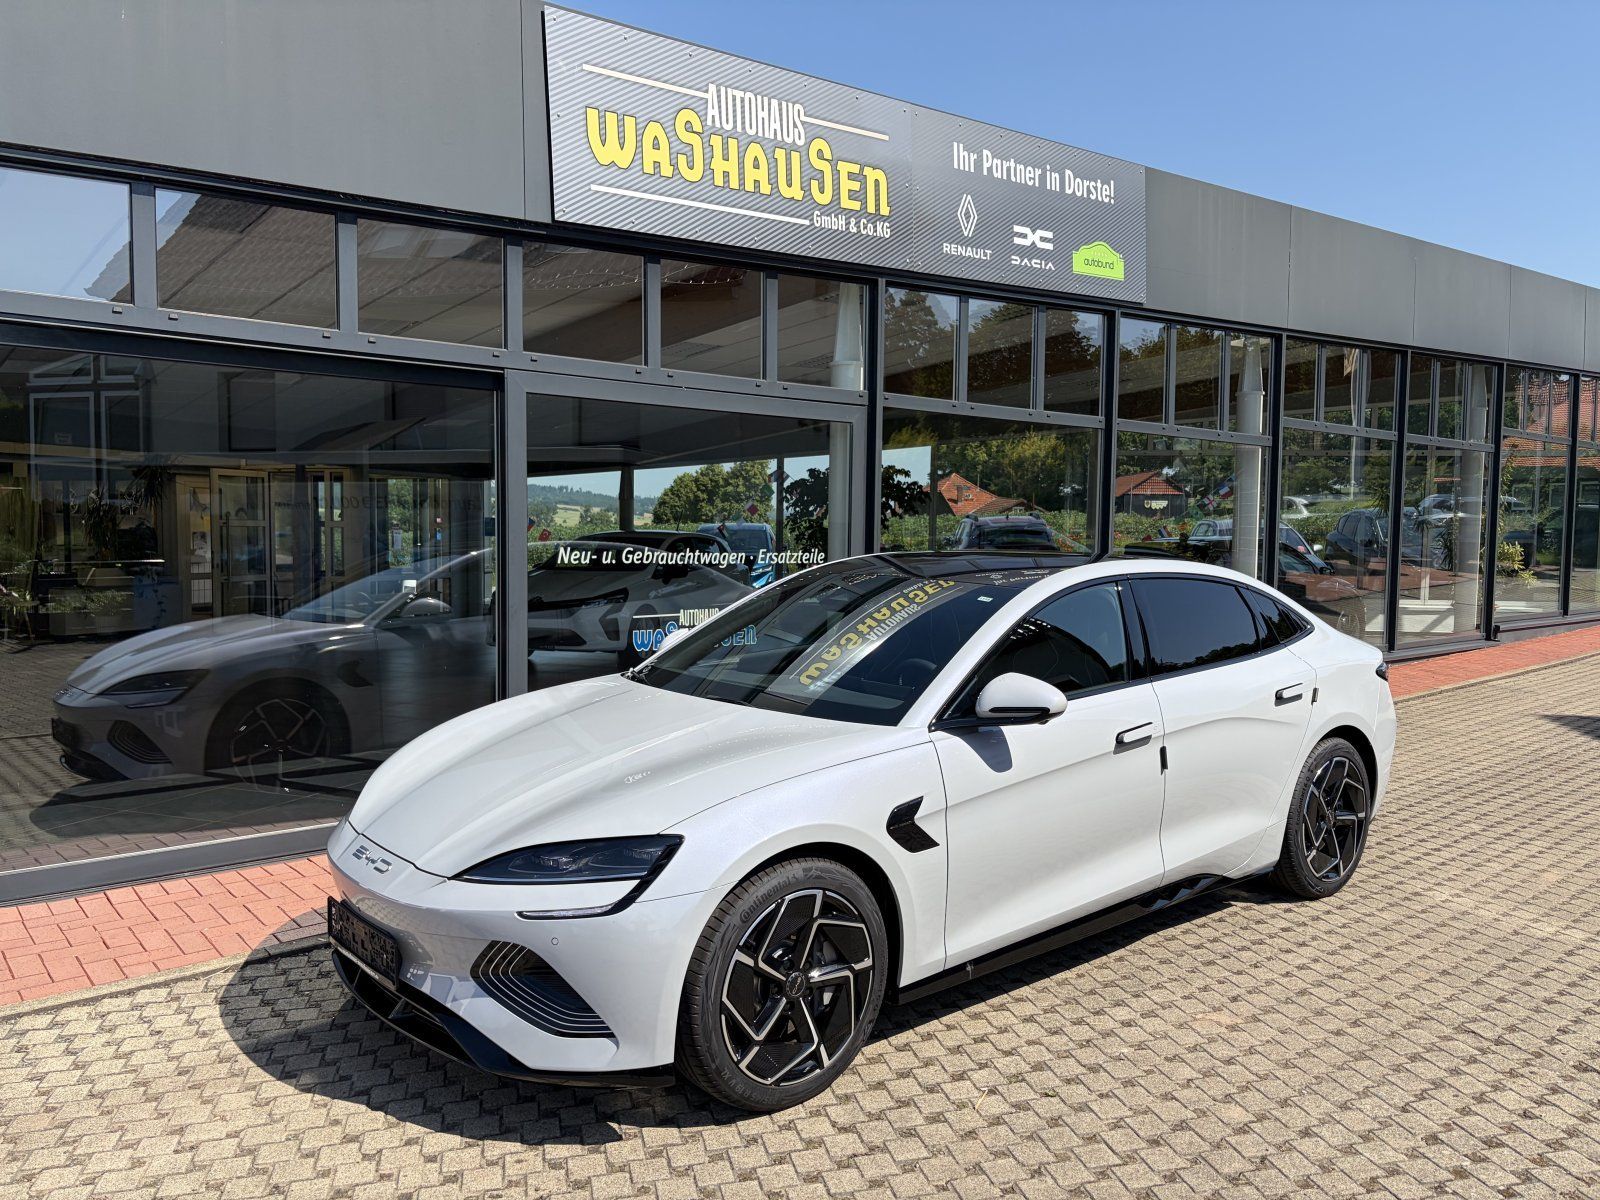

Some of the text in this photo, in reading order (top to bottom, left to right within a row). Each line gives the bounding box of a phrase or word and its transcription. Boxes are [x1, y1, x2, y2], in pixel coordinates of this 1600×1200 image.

[706, 83, 806, 146] AUTOHAUS
[952, 141, 1116, 205] Ihr Partner in Dorste!
[813, 210, 892, 239] GmbH & Co.KG
[942, 243, 993, 261] RENAULT
[1011, 255, 1056, 271] DACIA
[1083, 258, 1115, 271] autobund
[557, 546, 598, 565] Neu-
[602, 551, 616, 564] u.
[621, 547, 746, 569] Gebrauchtwagen
[757, 548, 825, 565] Ersatzteile
[679, 608, 720, 627] AUTOHA
